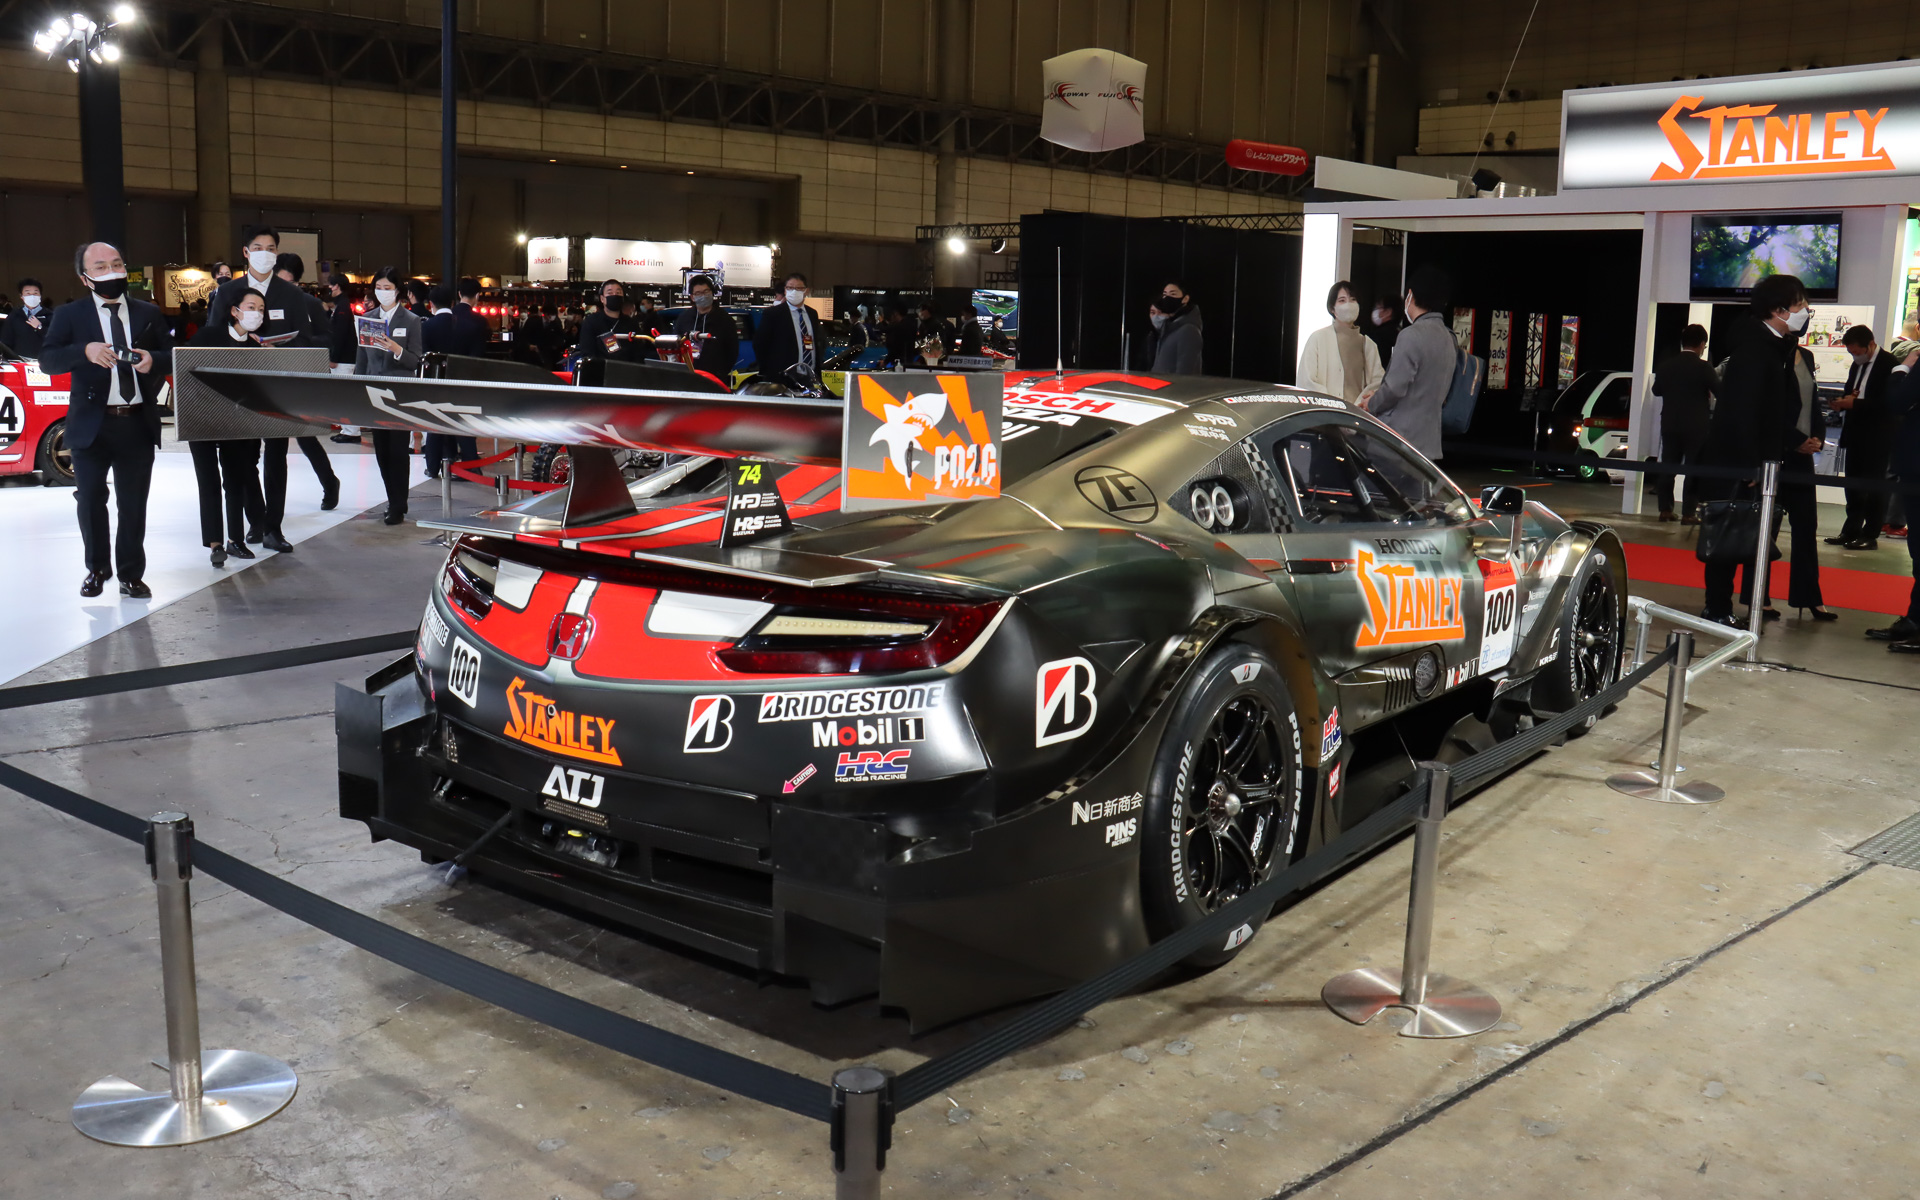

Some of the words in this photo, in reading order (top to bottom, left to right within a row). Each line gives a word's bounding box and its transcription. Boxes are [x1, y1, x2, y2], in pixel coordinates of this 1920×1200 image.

[1649, 95, 1897, 181] STANLEY
[614, 257, 646, 267] ahead
[647, 257, 664, 268] film
[737, 464, 762, 486] 74
[1076, 467, 1158, 518] ZF
[733, 515, 765, 532] HRS
[1375, 538, 1442, 555] HONDA
[1355, 549, 1465, 647] STANLEY
[1485, 588, 1515, 638] 100
[450, 645, 479, 699] 100
[1445, 661, 1470, 691] Mobil
[760, 685, 944, 723] BRIDGESTONE
[503, 676, 623, 767] STANLEY
[812, 717, 893, 748] Mobil
[792, 766, 815, 786] CAUTION
[835, 749, 912, 777] HRC
[870, 773, 907, 781] RACING
[1285, 711, 1303, 855] POTENZA
[1105, 817, 1137, 844] PINS
[1170, 740, 1195, 904] BRIDGESTONE
